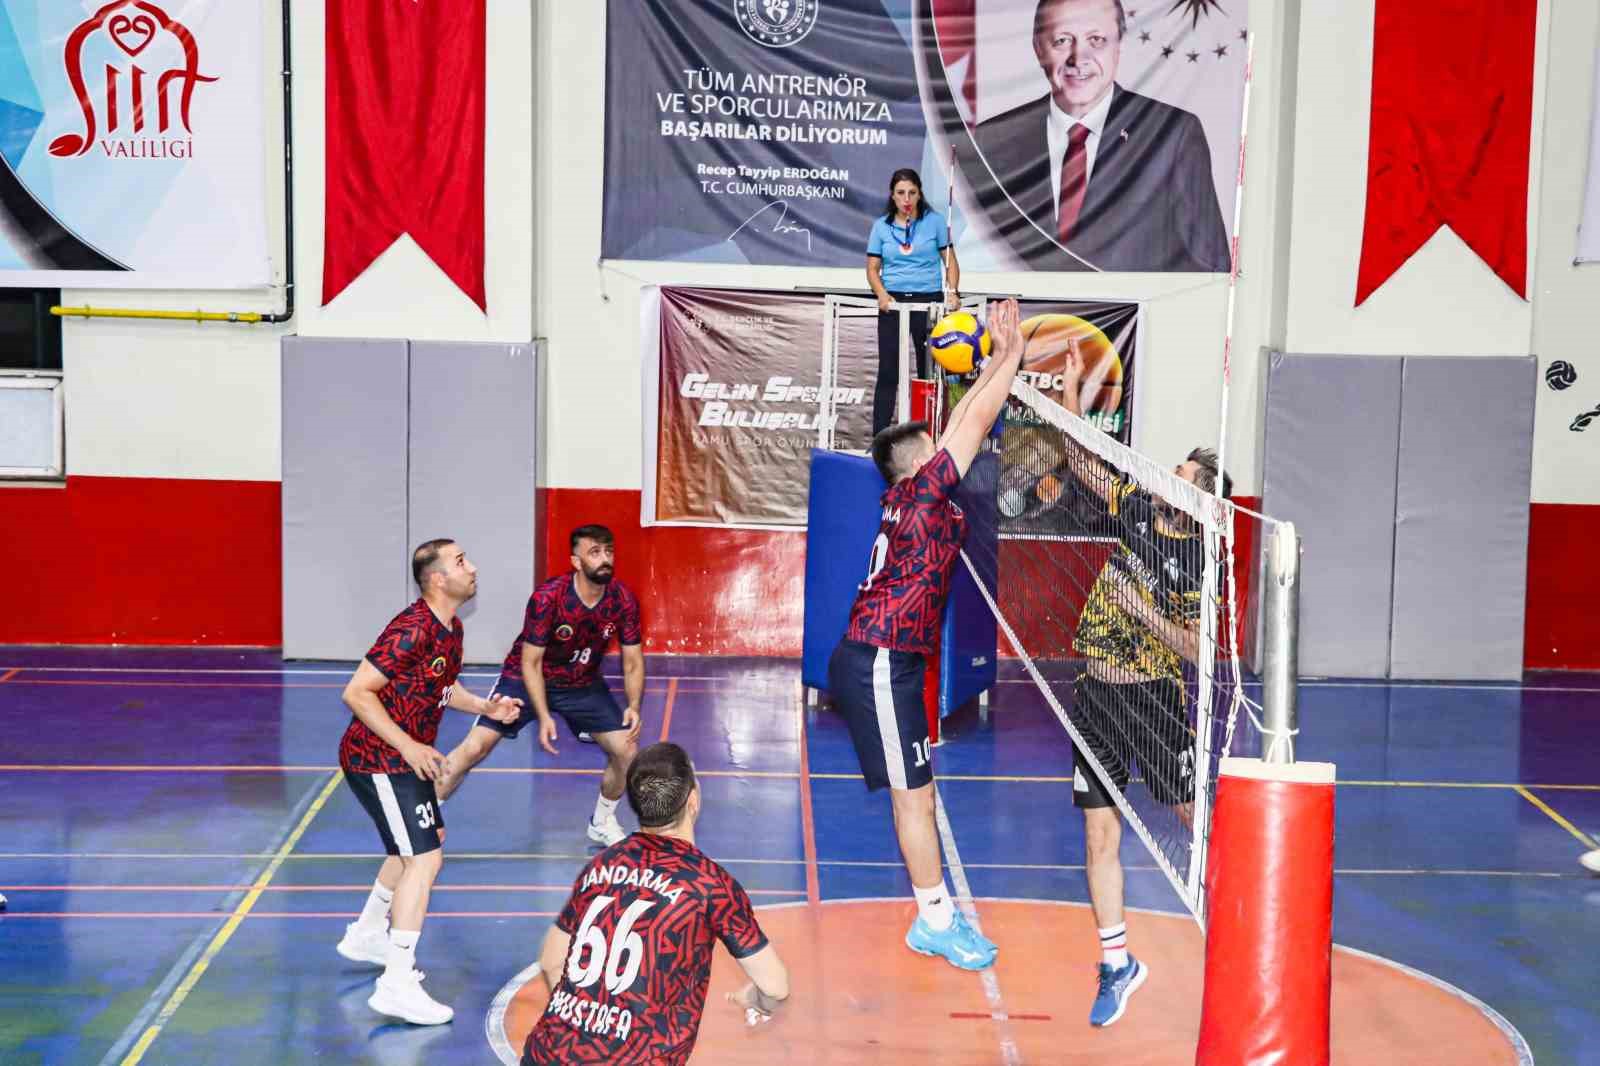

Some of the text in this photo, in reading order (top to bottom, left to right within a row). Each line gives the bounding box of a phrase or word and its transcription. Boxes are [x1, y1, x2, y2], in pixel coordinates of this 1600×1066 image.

[683, 67, 867, 98] TÜM ANTRENÖR
[656, 92, 893, 122] VE SPORCULARIMIZA
[661, 119, 888, 145] BAŞARILAR DİLİYORUM
[697, 163, 849, 181] Recep Tayyip ERDOĞAN
[701, 180, 845, 201] T.C. CUMHURBAŞKANI
[912, 737, 932, 768] 10
[581, 866, 685, 906] JANDARMA
[567, 896, 656, 996] 66
[548, 989, 632, 1041] MUSTAFA
